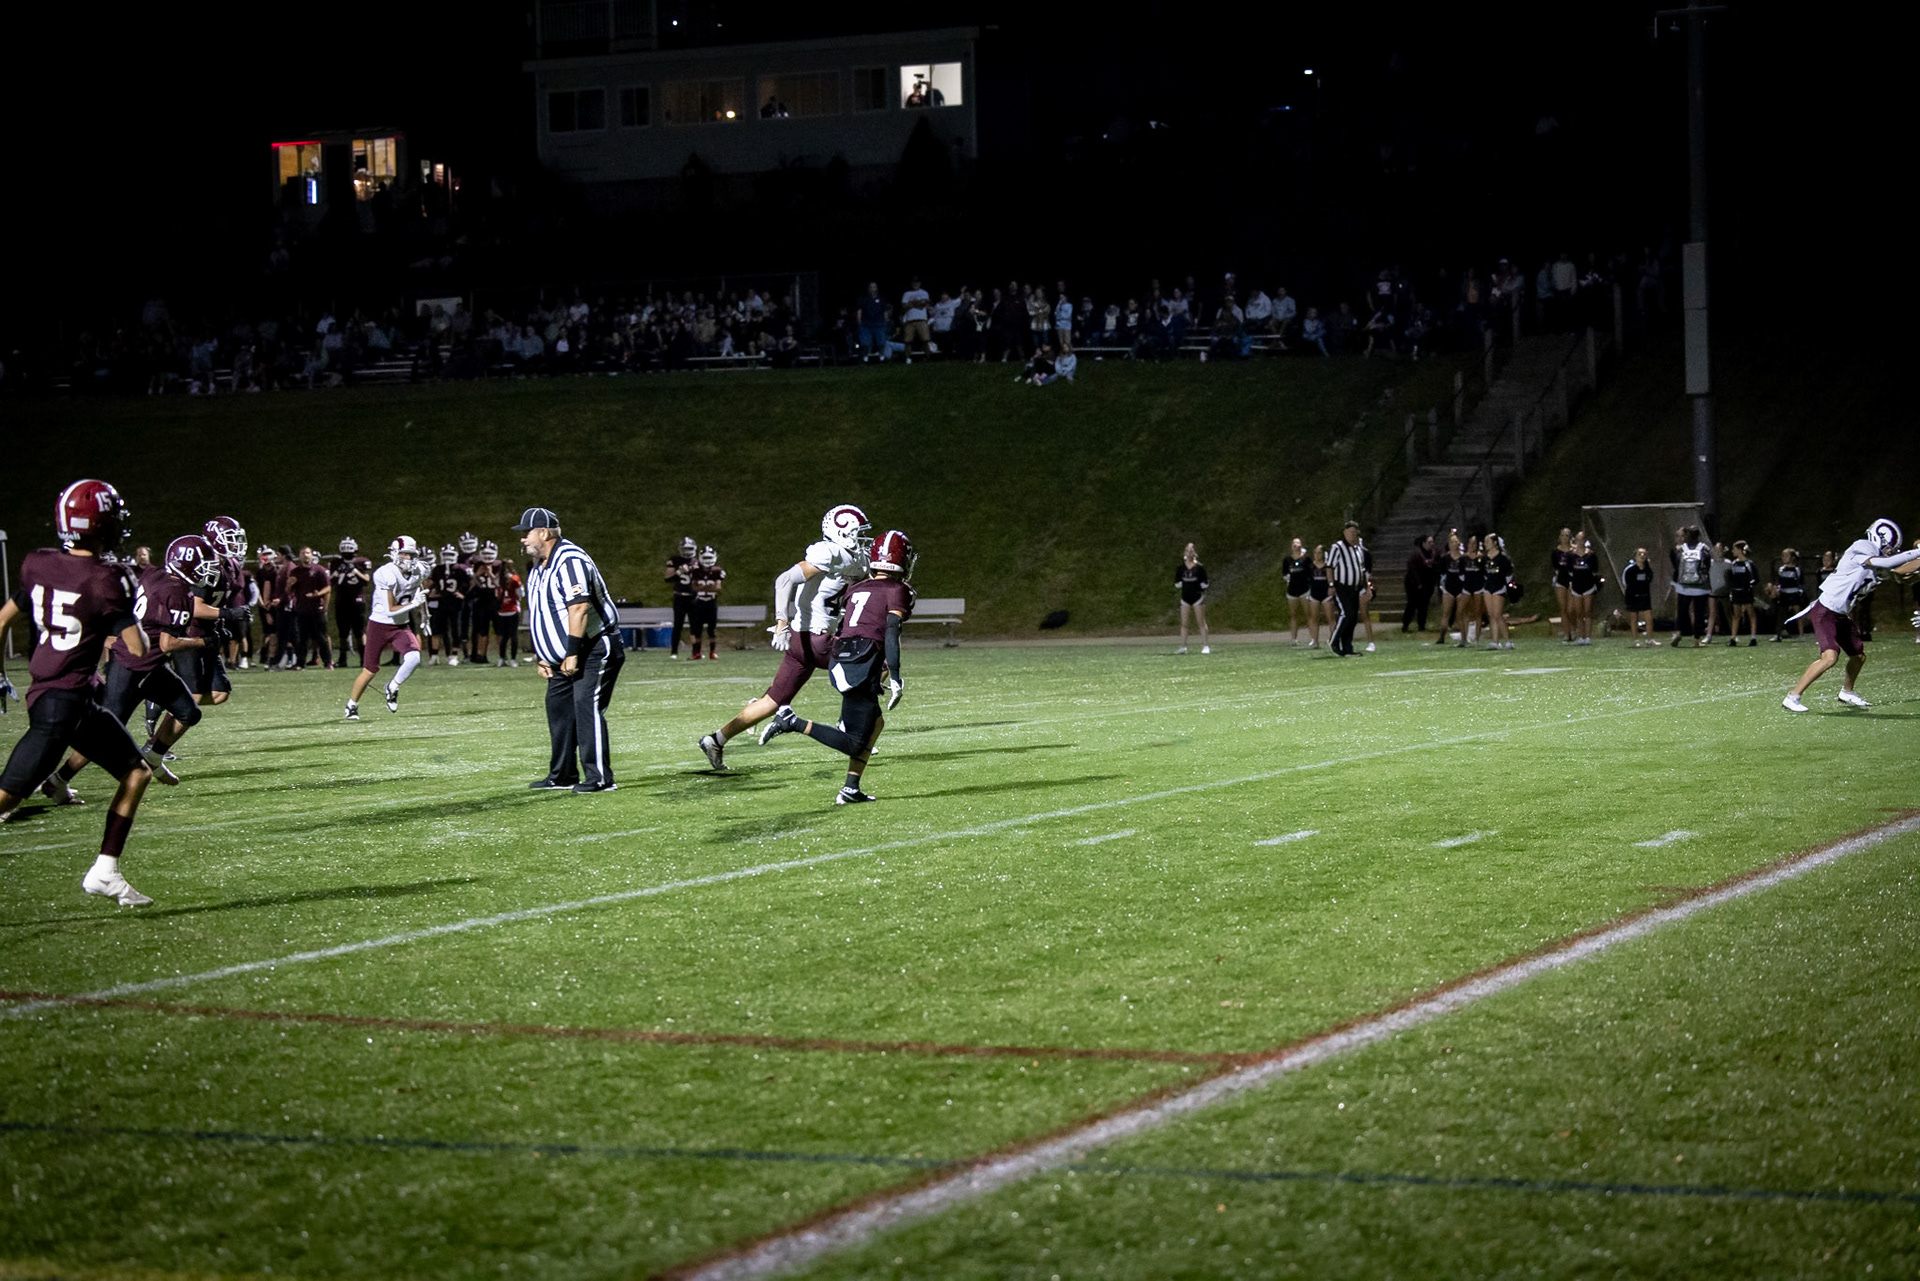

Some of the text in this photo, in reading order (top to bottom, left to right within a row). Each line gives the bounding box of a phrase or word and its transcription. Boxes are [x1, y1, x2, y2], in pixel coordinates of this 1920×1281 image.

[95, 491, 113, 512] 15
[178, 546, 194, 561] 78
[438, 578, 458, 593] 13
[30, 584, 82, 651] 15
[169, 609, 191, 626] 78
[849, 591, 872, 628] 7
